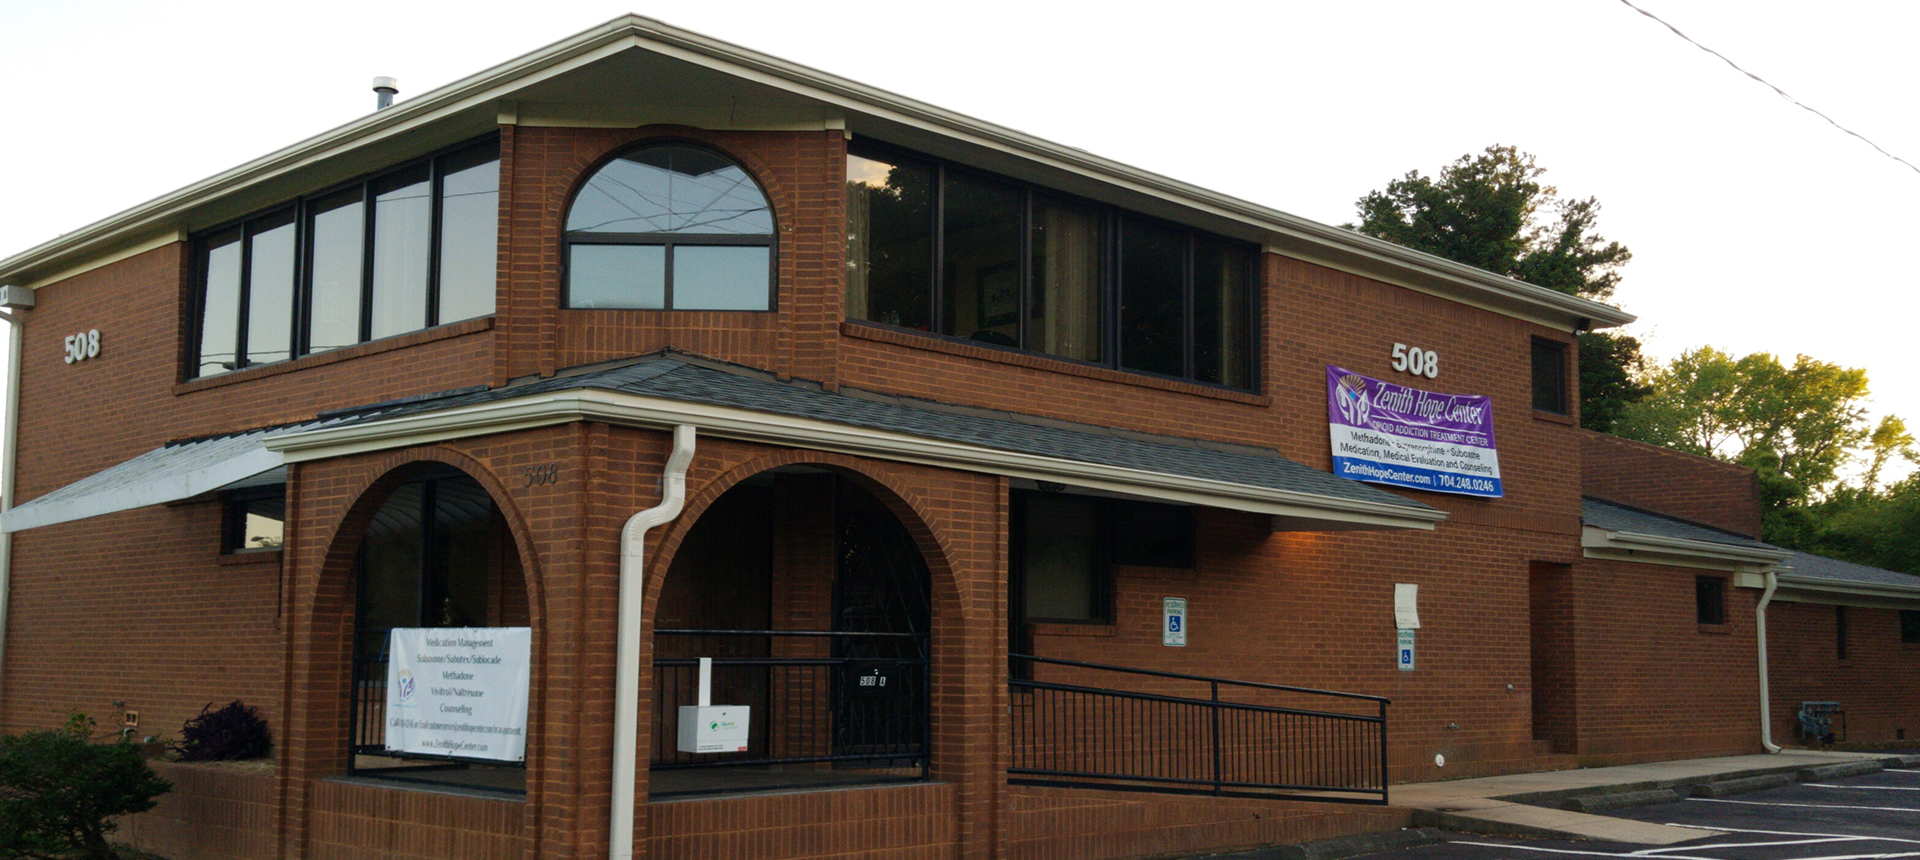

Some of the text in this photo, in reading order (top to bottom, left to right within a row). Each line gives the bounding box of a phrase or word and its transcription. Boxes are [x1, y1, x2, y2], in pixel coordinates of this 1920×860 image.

[65, 329, 101, 364] 508
[1391, 342, 1438, 379] 508
[1373, 382, 1482, 425] Zenith Hope Center
[1372, 420, 1489, 447] OPIOID ADDICTION TREATMENT CENTER
[1340, 442, 1493, 476] Medication, Medical Evaluation and Counseling
[1450, 447, 1481, 461] Suboxone
[523, 462, 558, 488] 508
[1343, 462, 1431, 485] ZenithHopeCenter.com
[1438, 474, 1495, 492] 704.248.0246
[426, 637, 494, 650] Medication Management
[442, 670, 475, 680] Methadone
[860, 675, 876, 686] 508
[440, 702, 473, 716] Counseling
